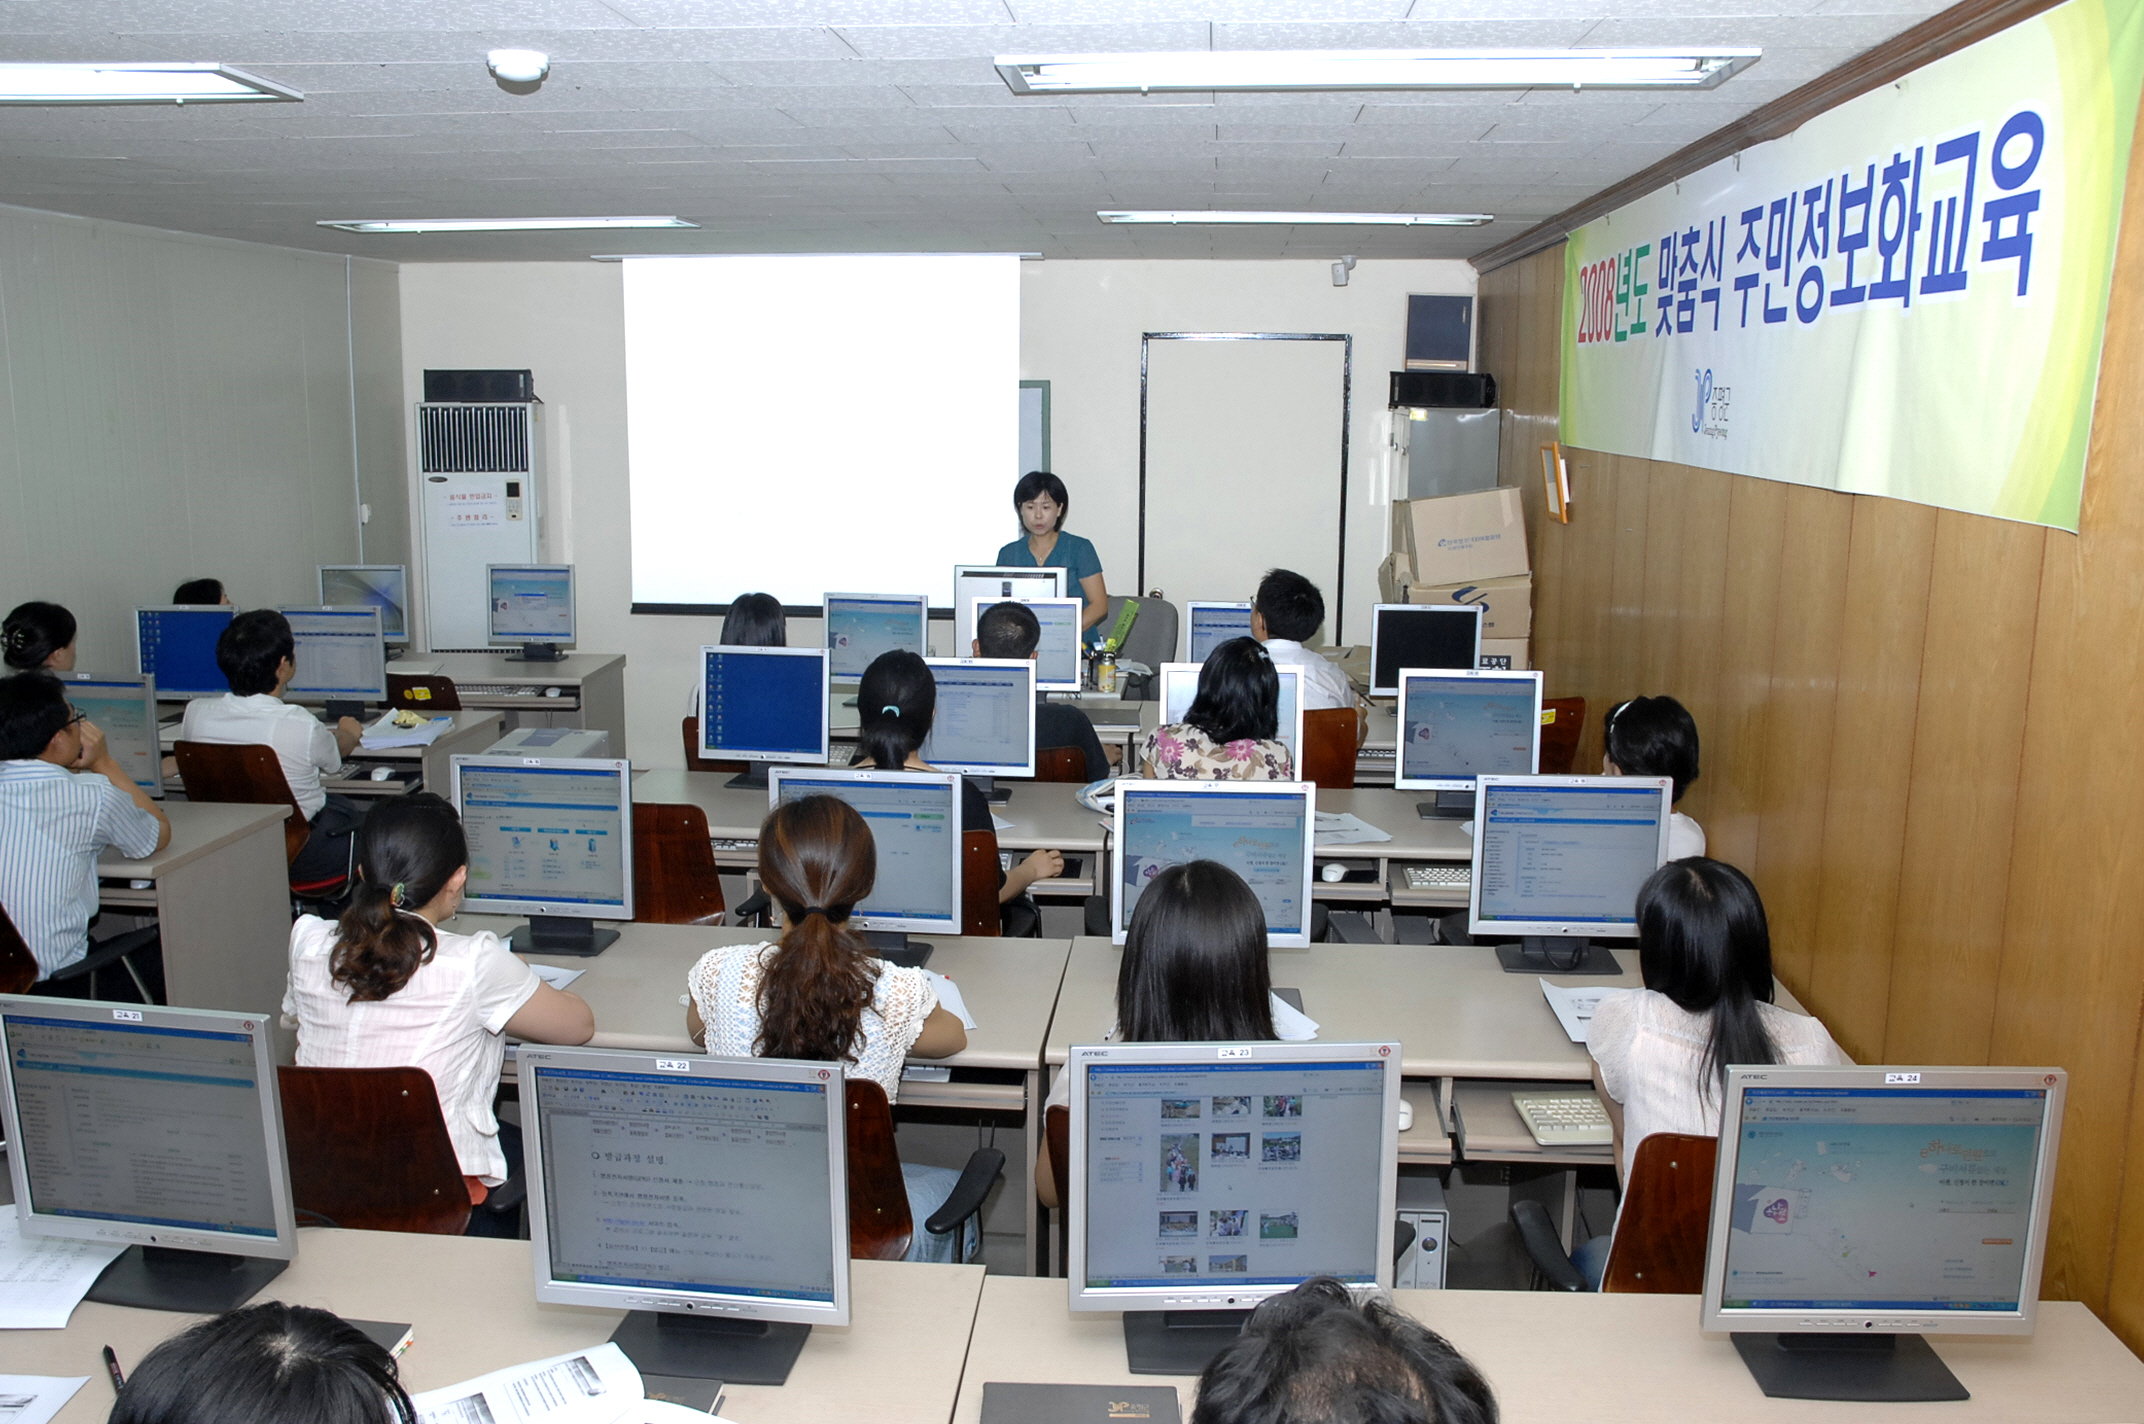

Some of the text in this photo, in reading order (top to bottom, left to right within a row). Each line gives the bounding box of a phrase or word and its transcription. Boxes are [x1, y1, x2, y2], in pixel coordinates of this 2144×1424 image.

[1577, 110, 2045, 343] 2008년도 맞춤식 주민정보화교육
[1239, 1048, 1250, 1057] 23
[676, 1062, 688, 1070] 22
[1906, 1074, 1918, 1082] 24
